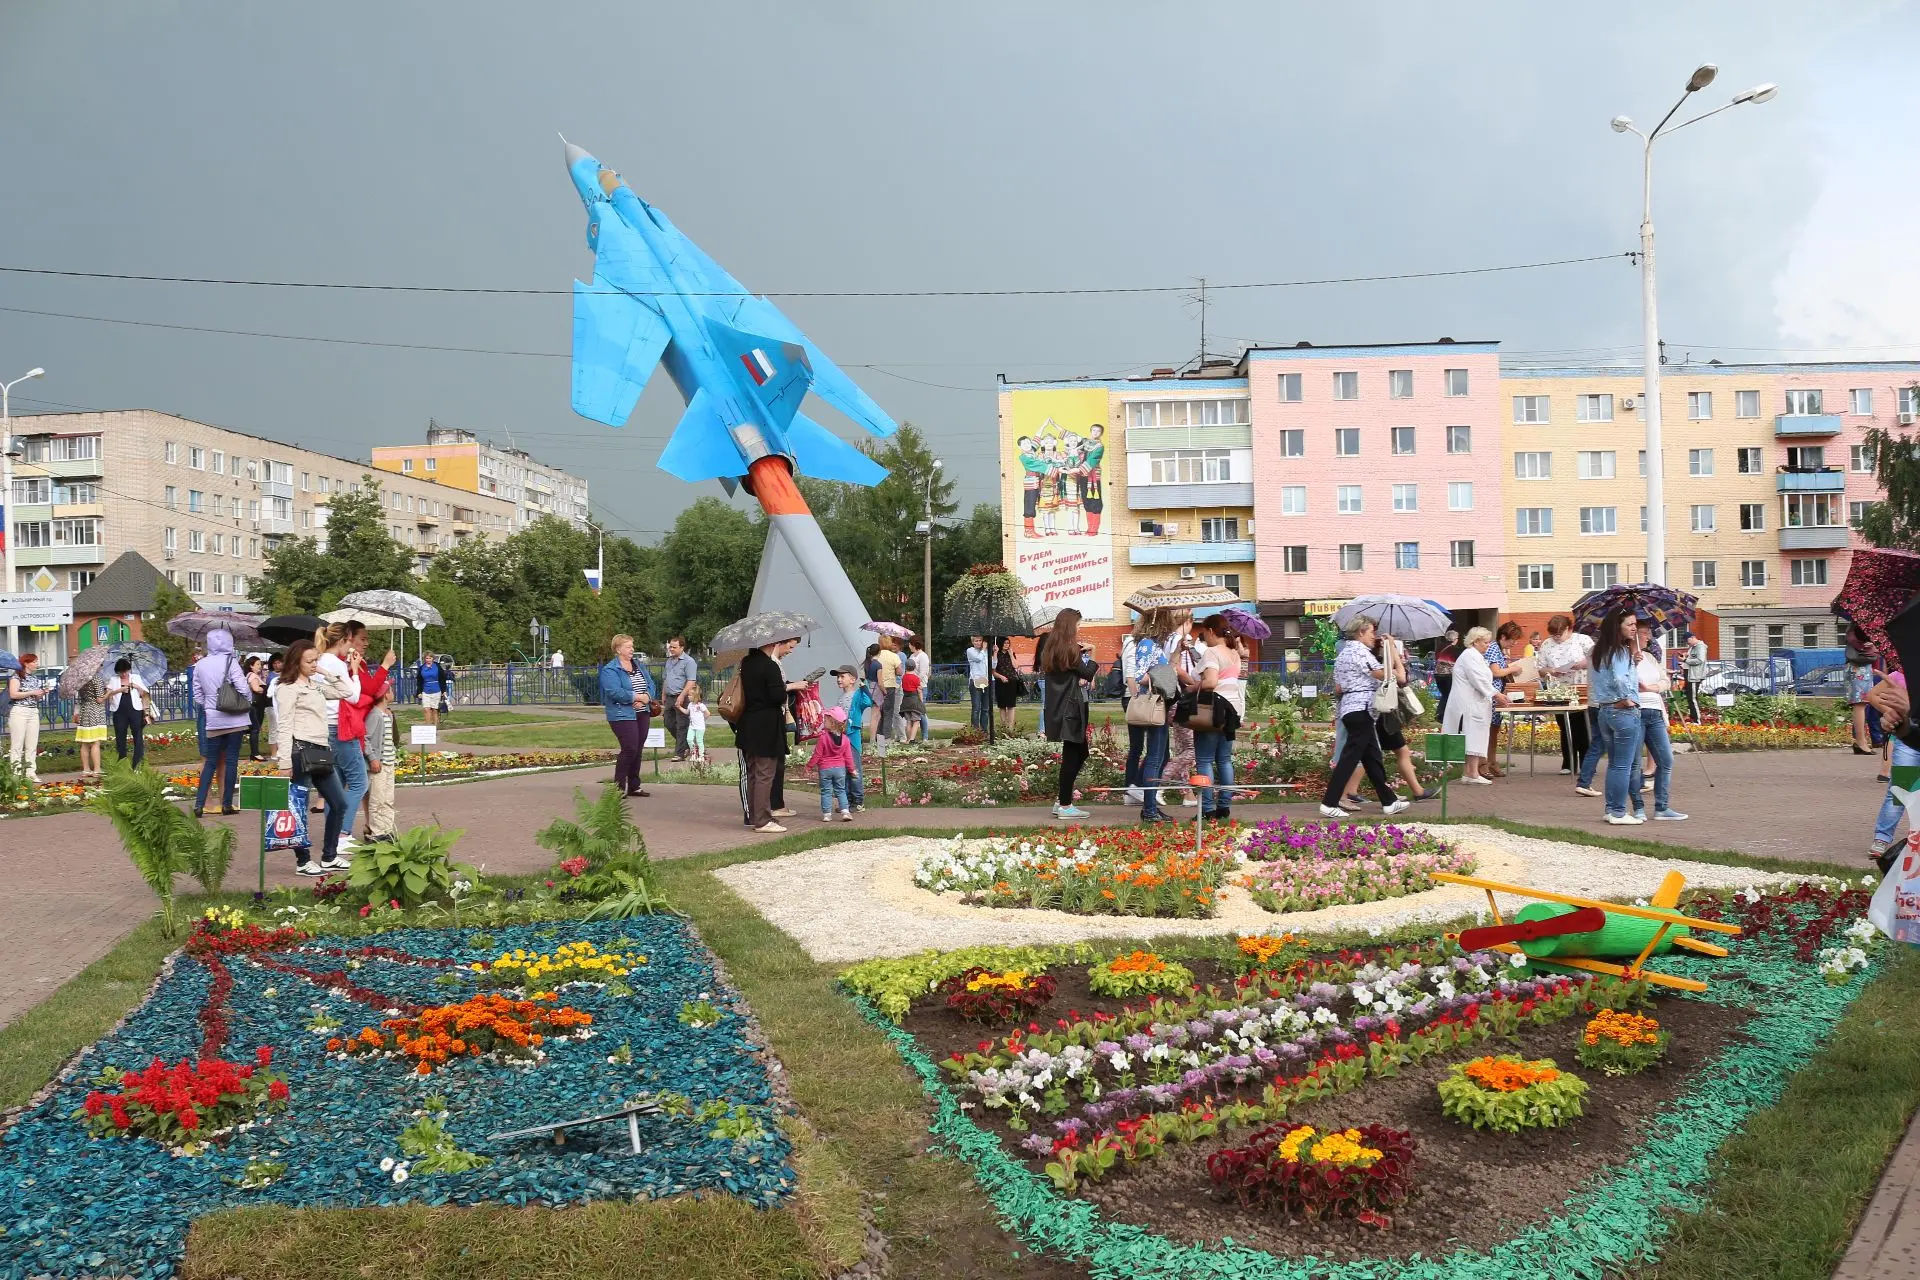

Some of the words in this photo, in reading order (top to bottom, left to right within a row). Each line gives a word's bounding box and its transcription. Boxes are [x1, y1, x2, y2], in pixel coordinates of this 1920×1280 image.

[1019, 550, 1052, 563] БУДЕМ
[1042, 552, 1088, 568] ЛУЧШЕМУ
[1053, 556, 1108, 575] СТРЕМИТЬСЯ
[1044, 578, 1110, 602] ЛУХОВИЦЫ!
